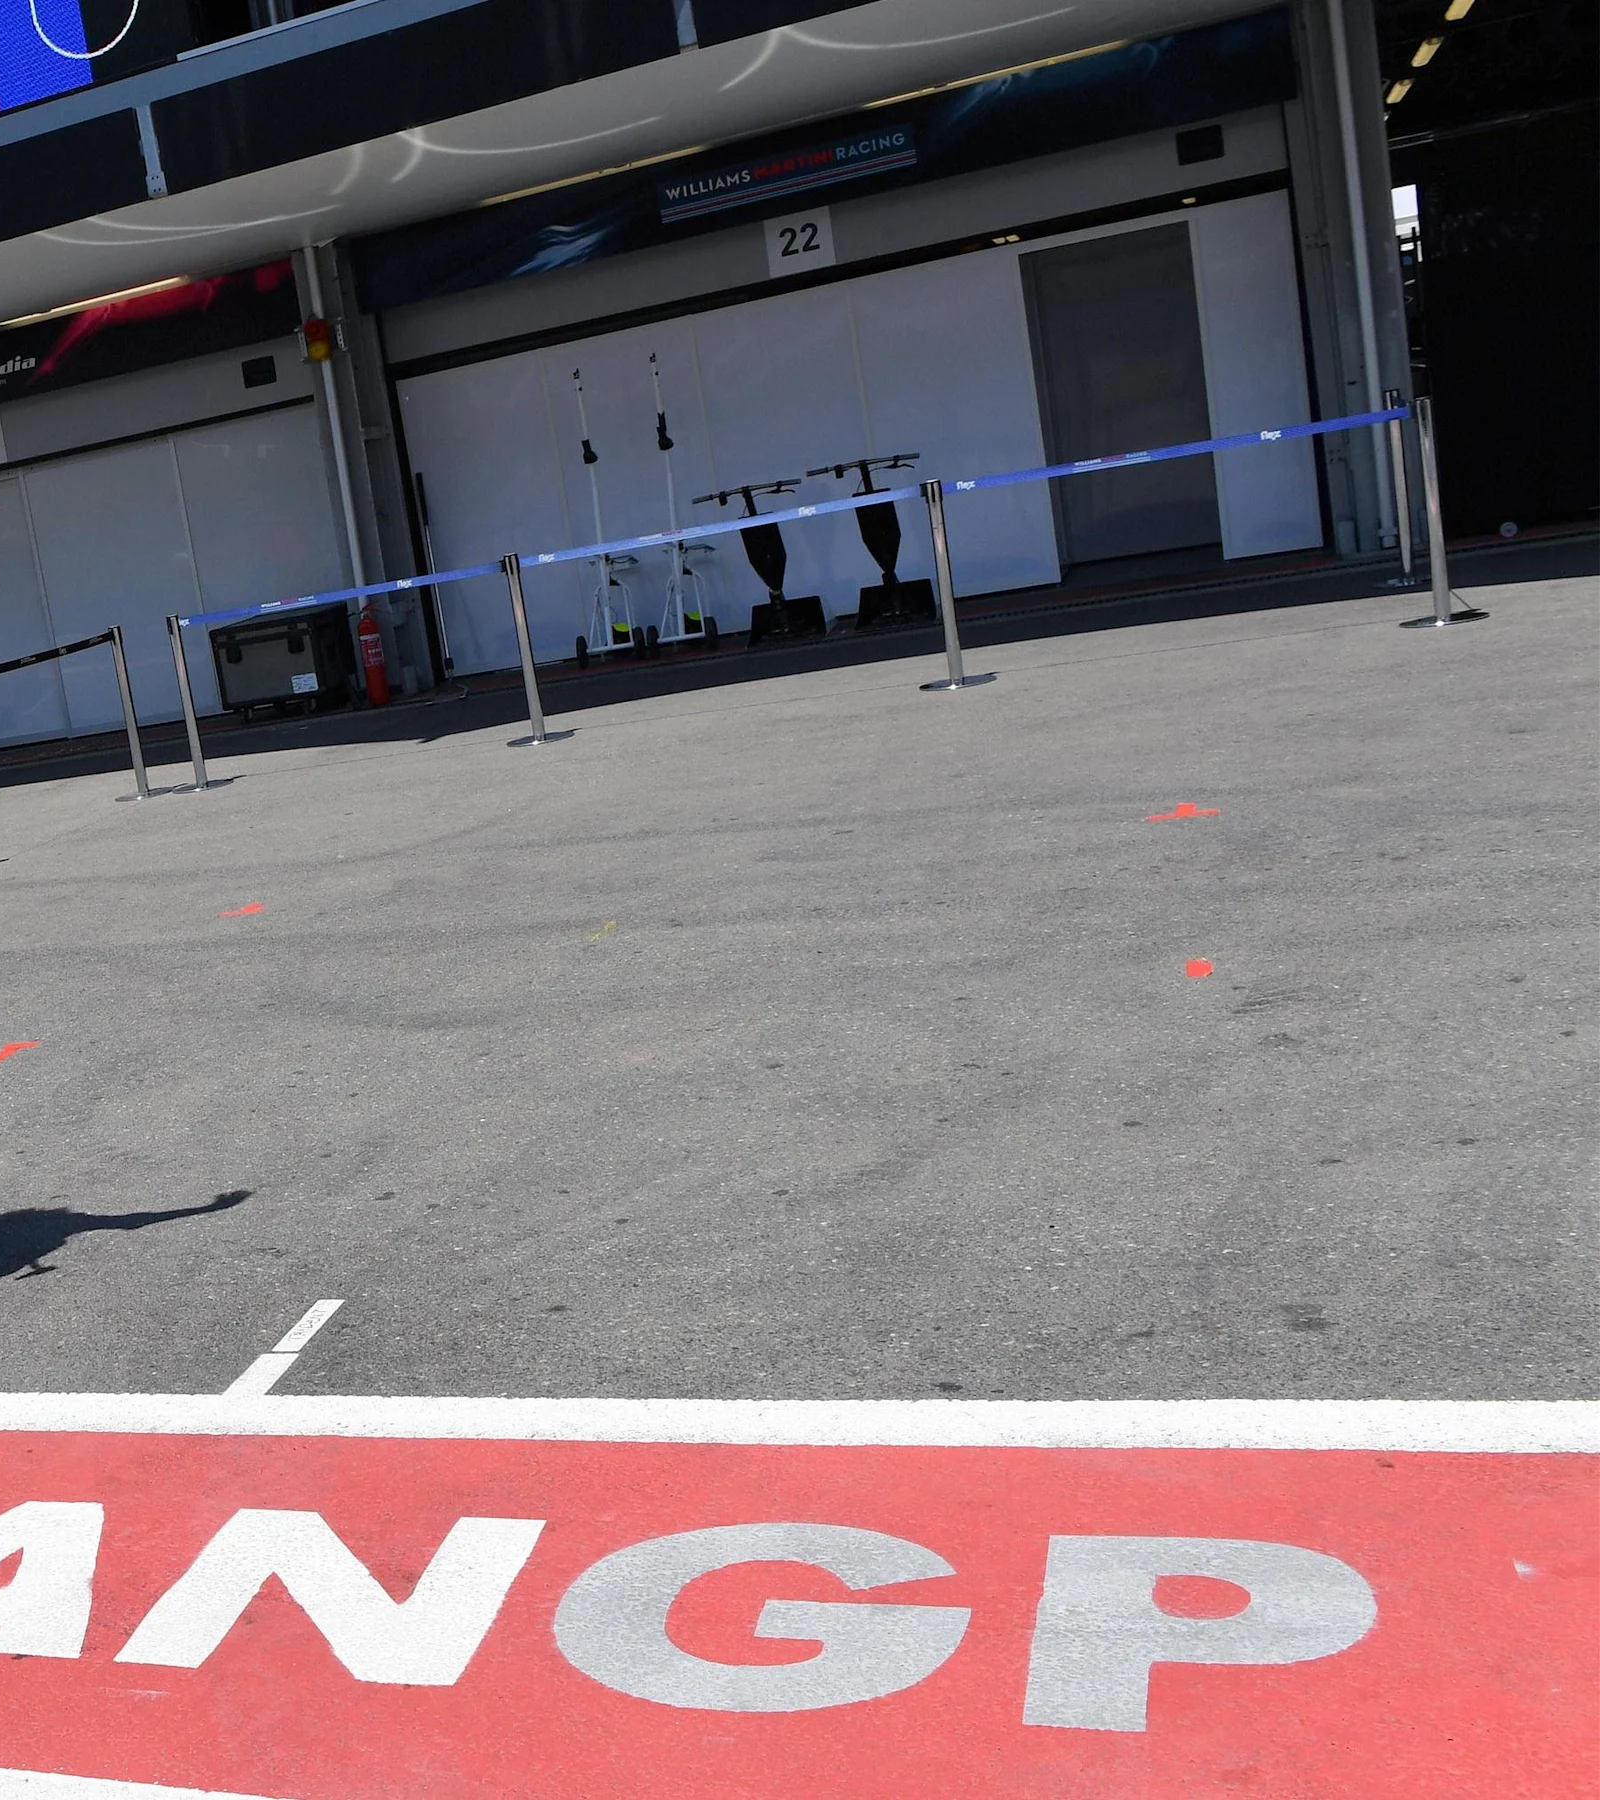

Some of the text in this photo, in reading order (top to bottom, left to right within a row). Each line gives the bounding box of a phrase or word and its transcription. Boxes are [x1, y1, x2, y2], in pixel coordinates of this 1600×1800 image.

[665, 131, 906, 201] WILLIAMS MARTINI RACING
[778, 222, 821, 257] 22
[1260, 430, 1282, 441] flex
[955, 479, 976, 491] flex
